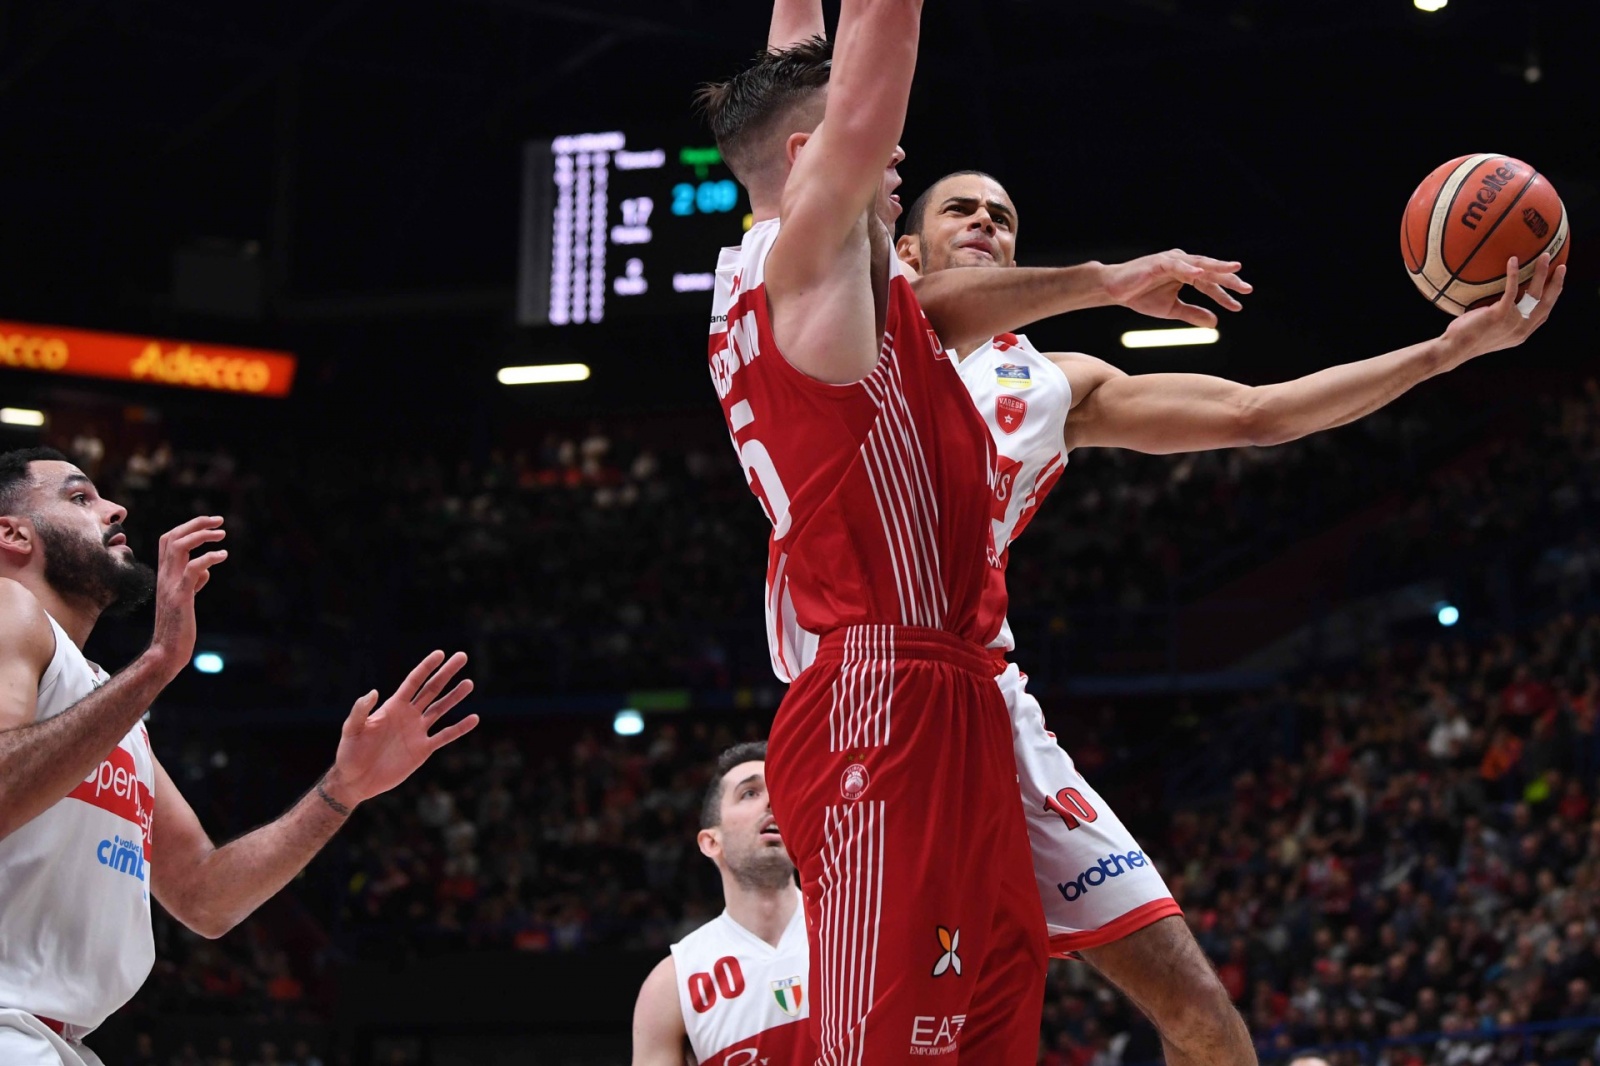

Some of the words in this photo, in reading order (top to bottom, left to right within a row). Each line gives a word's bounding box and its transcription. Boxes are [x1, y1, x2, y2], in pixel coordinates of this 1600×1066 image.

[130, 341, 271, 392] Adecco
[999, 397, 1024, 410] VARESE
[1044, 787, 1098, 831] 10
[1057, 850, 1149, 901] brother
[688, 955, 745, 1014] 00
[911, 1014, 967, 1046] EA7
